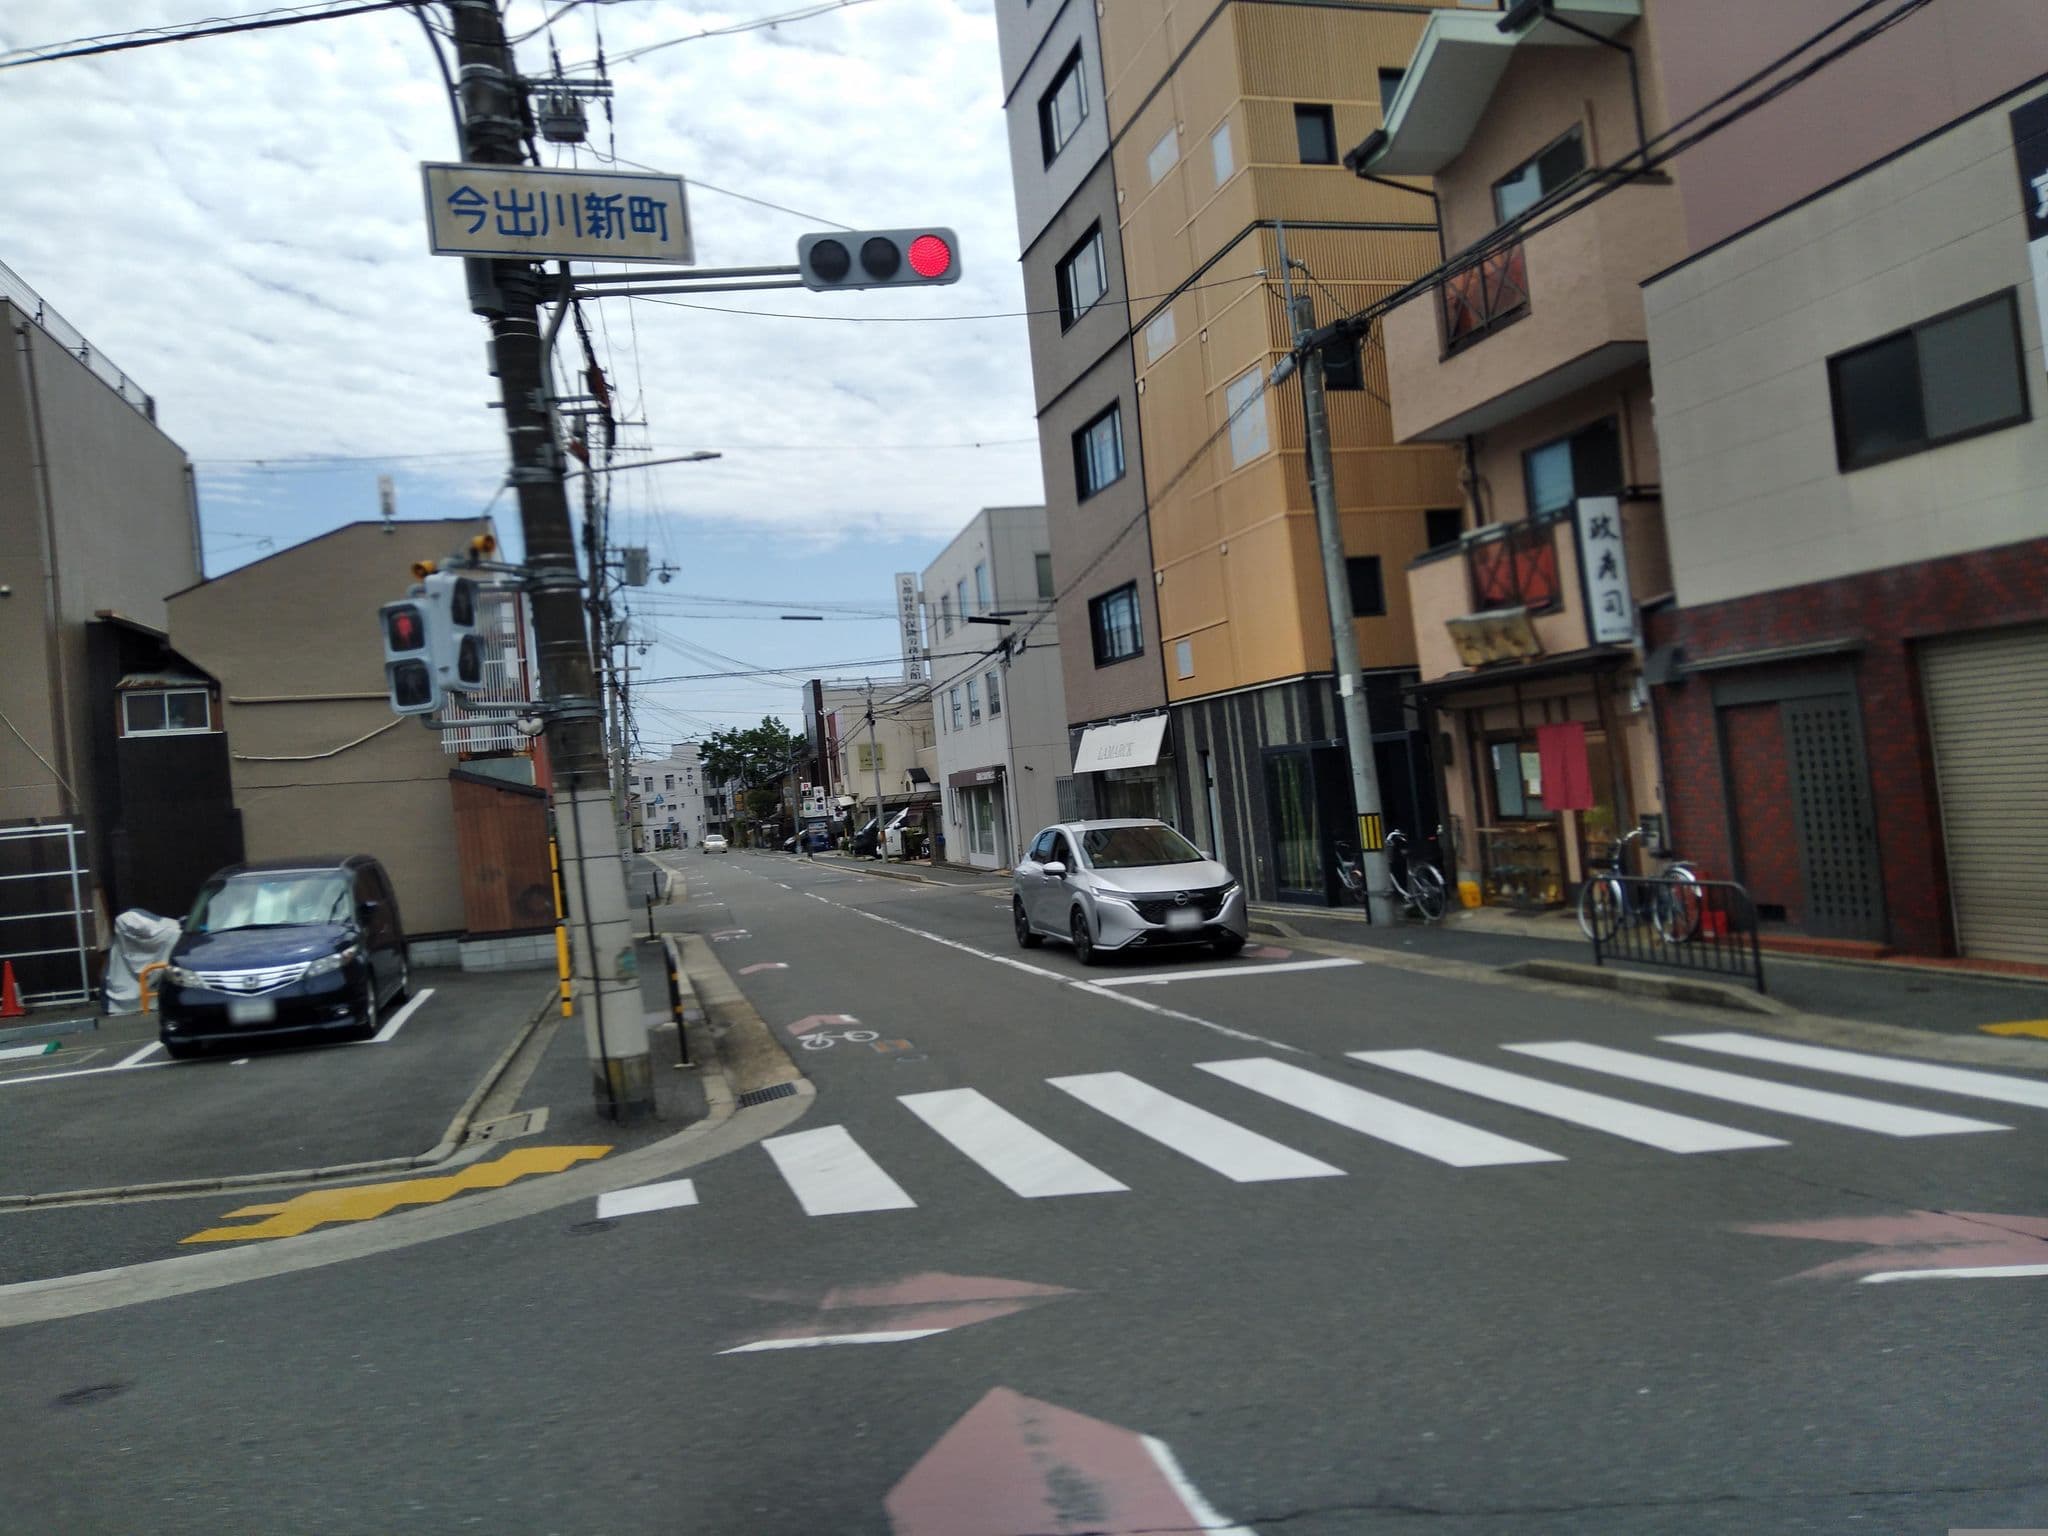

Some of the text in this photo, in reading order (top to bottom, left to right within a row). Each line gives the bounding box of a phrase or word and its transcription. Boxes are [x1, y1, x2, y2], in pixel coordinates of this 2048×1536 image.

[448, 185, 668, 242] 今出川新町
